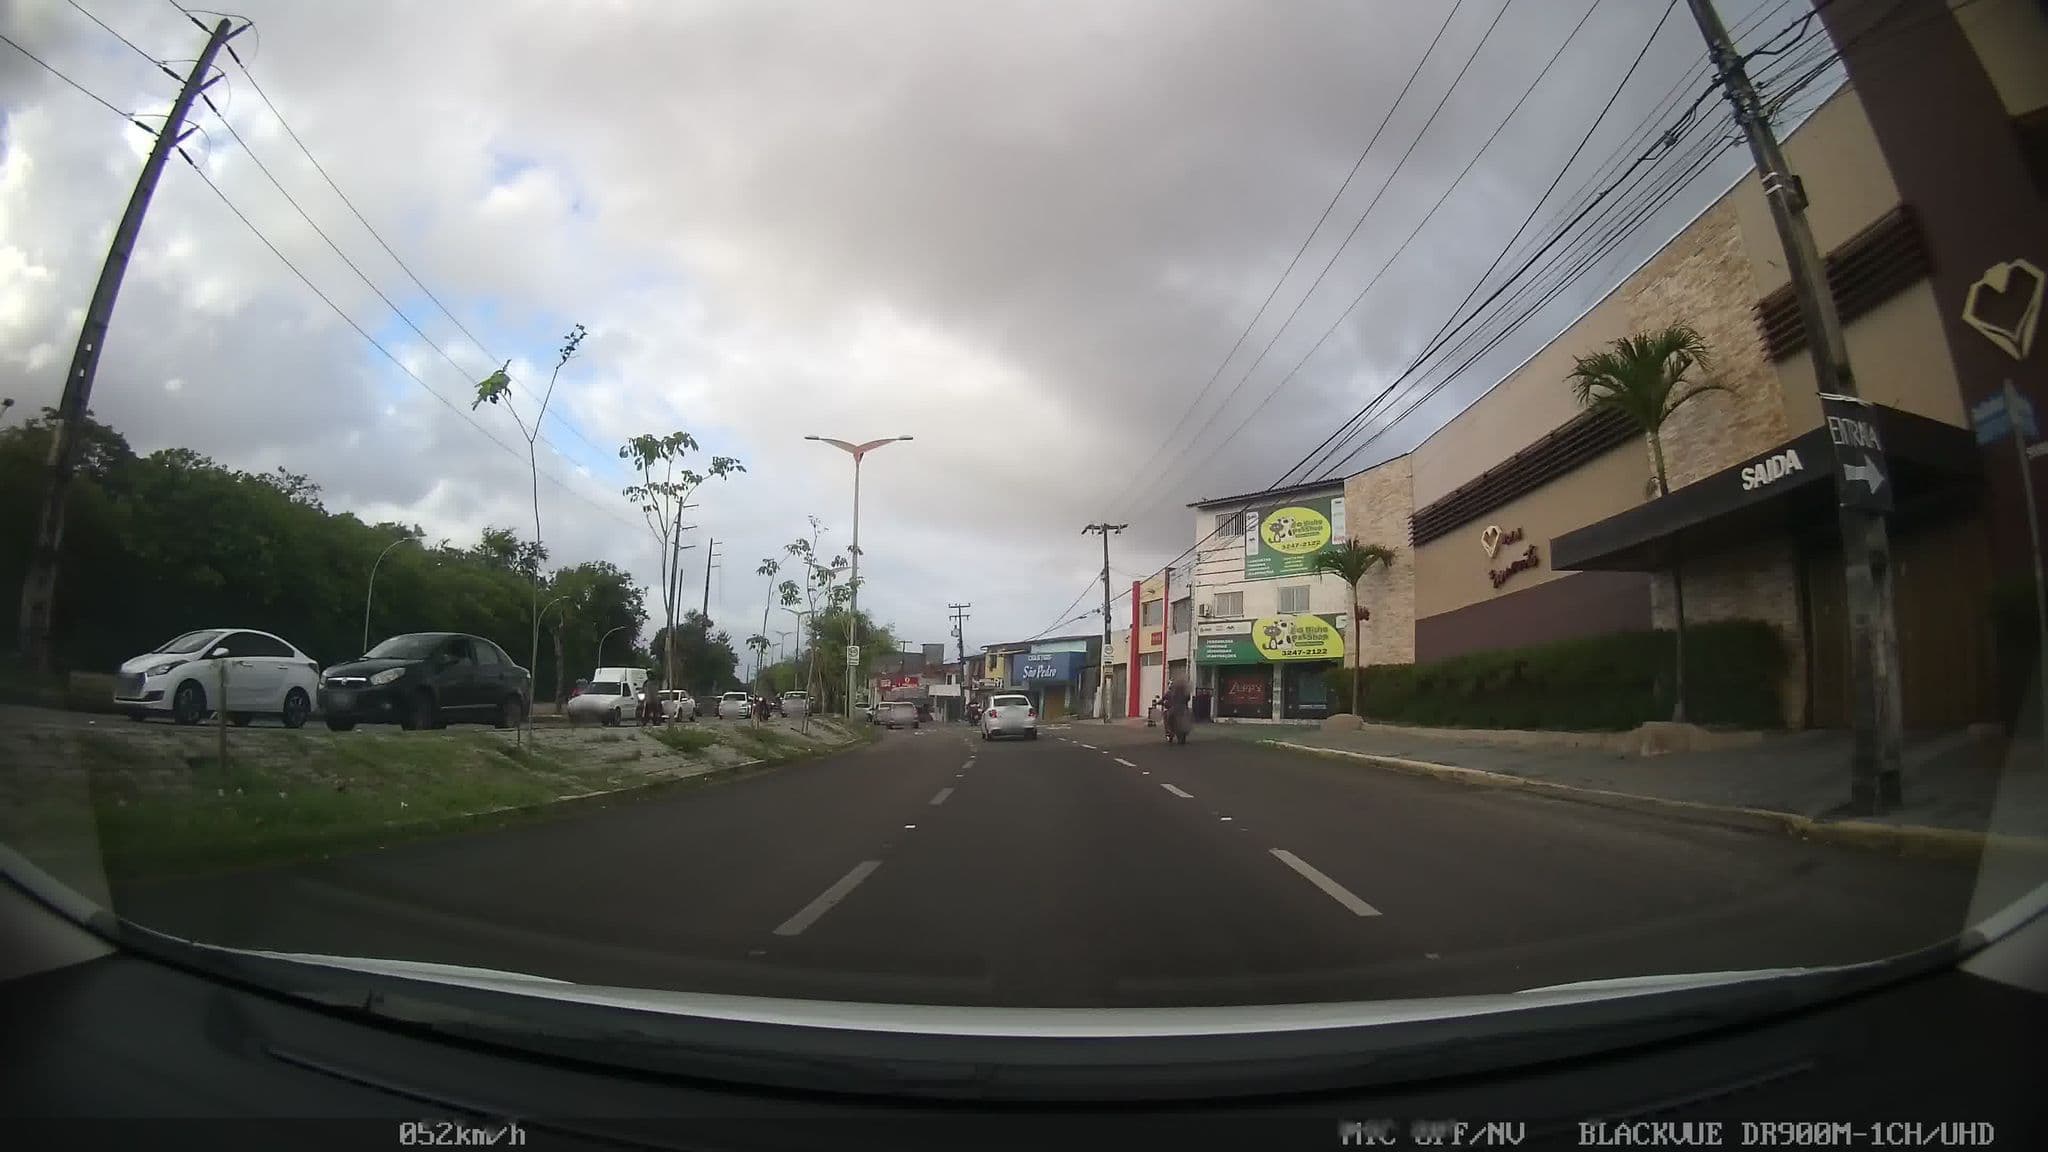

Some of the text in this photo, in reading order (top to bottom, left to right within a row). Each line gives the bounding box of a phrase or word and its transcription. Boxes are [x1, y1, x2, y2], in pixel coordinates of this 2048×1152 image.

[1741, 449, 1803, 490] SAIDA
[1281, 540, 1321, 550] 3247-2122
[1282, 648, 1328, 656] 3247-2122
[1037, 664, 1057, 678] Pedro
